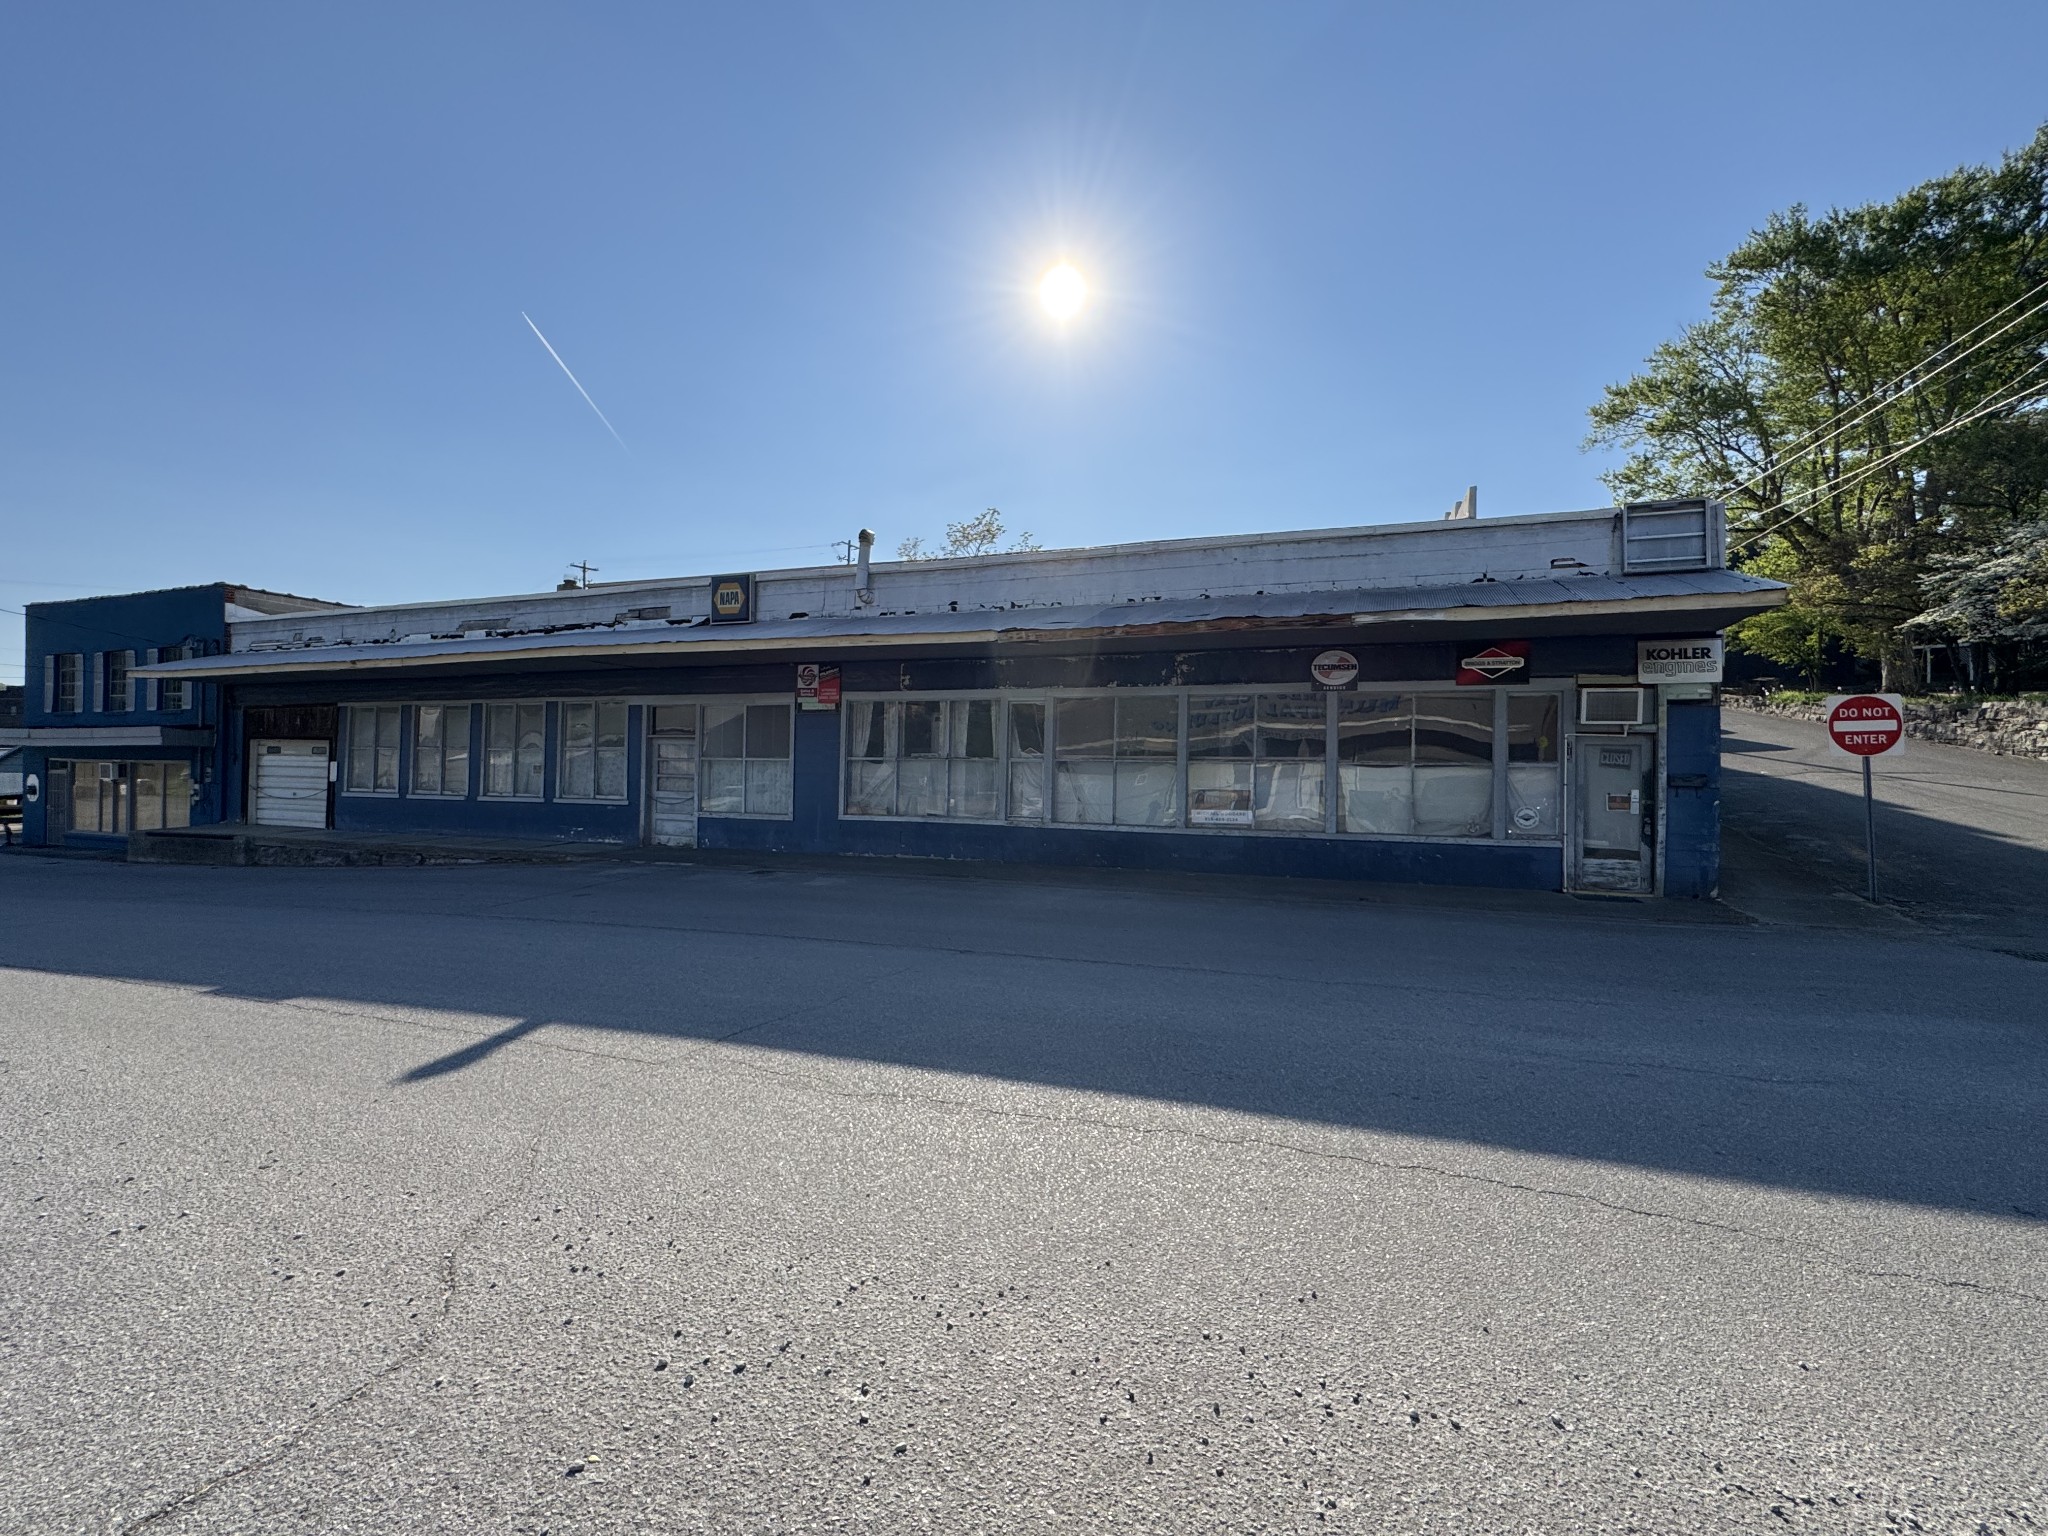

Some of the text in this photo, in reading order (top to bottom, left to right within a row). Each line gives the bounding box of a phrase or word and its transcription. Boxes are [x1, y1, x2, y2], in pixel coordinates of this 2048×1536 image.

[720, 591, 740, 605] NAPA
[1646, 647, 1712, 660] KOHLER
[1313, 663, 1357, 671] TECUMSEH
[1491, 659, 1521, 667] STRATTON
[1642, 660, 1718, 677] engines
[1839, 707, 1891, 718] DO NOT
[1845, 734, 1887, 745] ENTER
[1601, 752, 1631, 765] CLOSED
